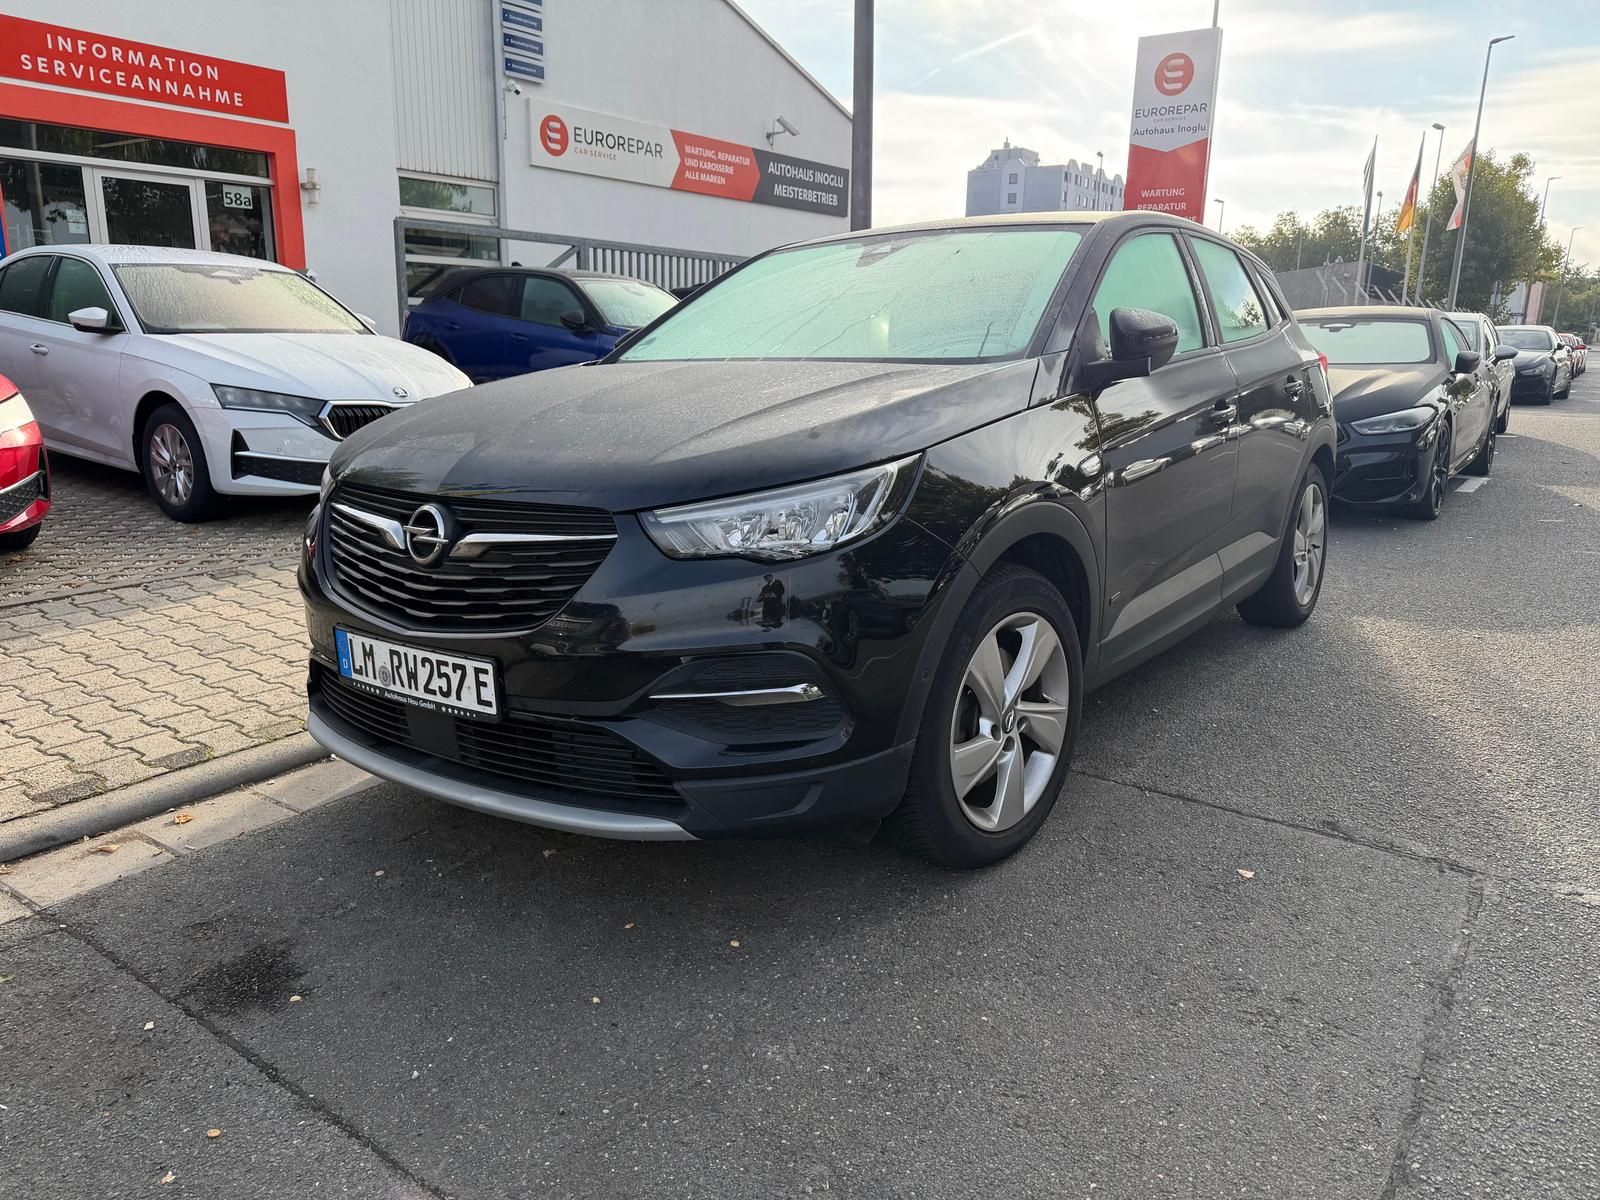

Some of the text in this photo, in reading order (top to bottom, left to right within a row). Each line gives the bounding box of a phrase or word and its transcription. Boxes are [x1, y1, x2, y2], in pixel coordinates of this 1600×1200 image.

[46, 33, 219, 81] INFORMATION
[20, 54, 243, 107] SERVICEANNAHME
[1135, 103, 1207, 118] EUROREPAR
[1133, 123, 1206, 136] Autohaus Inoglu
[573, 126, 663, 159] EUROREPAR
[574, 147, 617, 161] CAR SERVICE
[684, 144, 751, 166] WARTUNG, REPARATUR
[684, 157, 735, 175] UND KAROSSERIE
[768, 161, 844, 188] AUTOHAUS INOGLU
[684, 170, 726, 185] ALLE MARKEN
[225, 191, 252, 207] 58a
[773, 183, 838, 206] MEISTERBETRIEB
[1141, 187, 1185, 198] WARTUNG
[1137, 202, 1187, 211] REPARATUR
[342, 657, 348, 669] D
[349, 638, 377, 681] LM
[384, 690, 408, 704] Autohaus
[419, 699, 437, 710] GmbH
